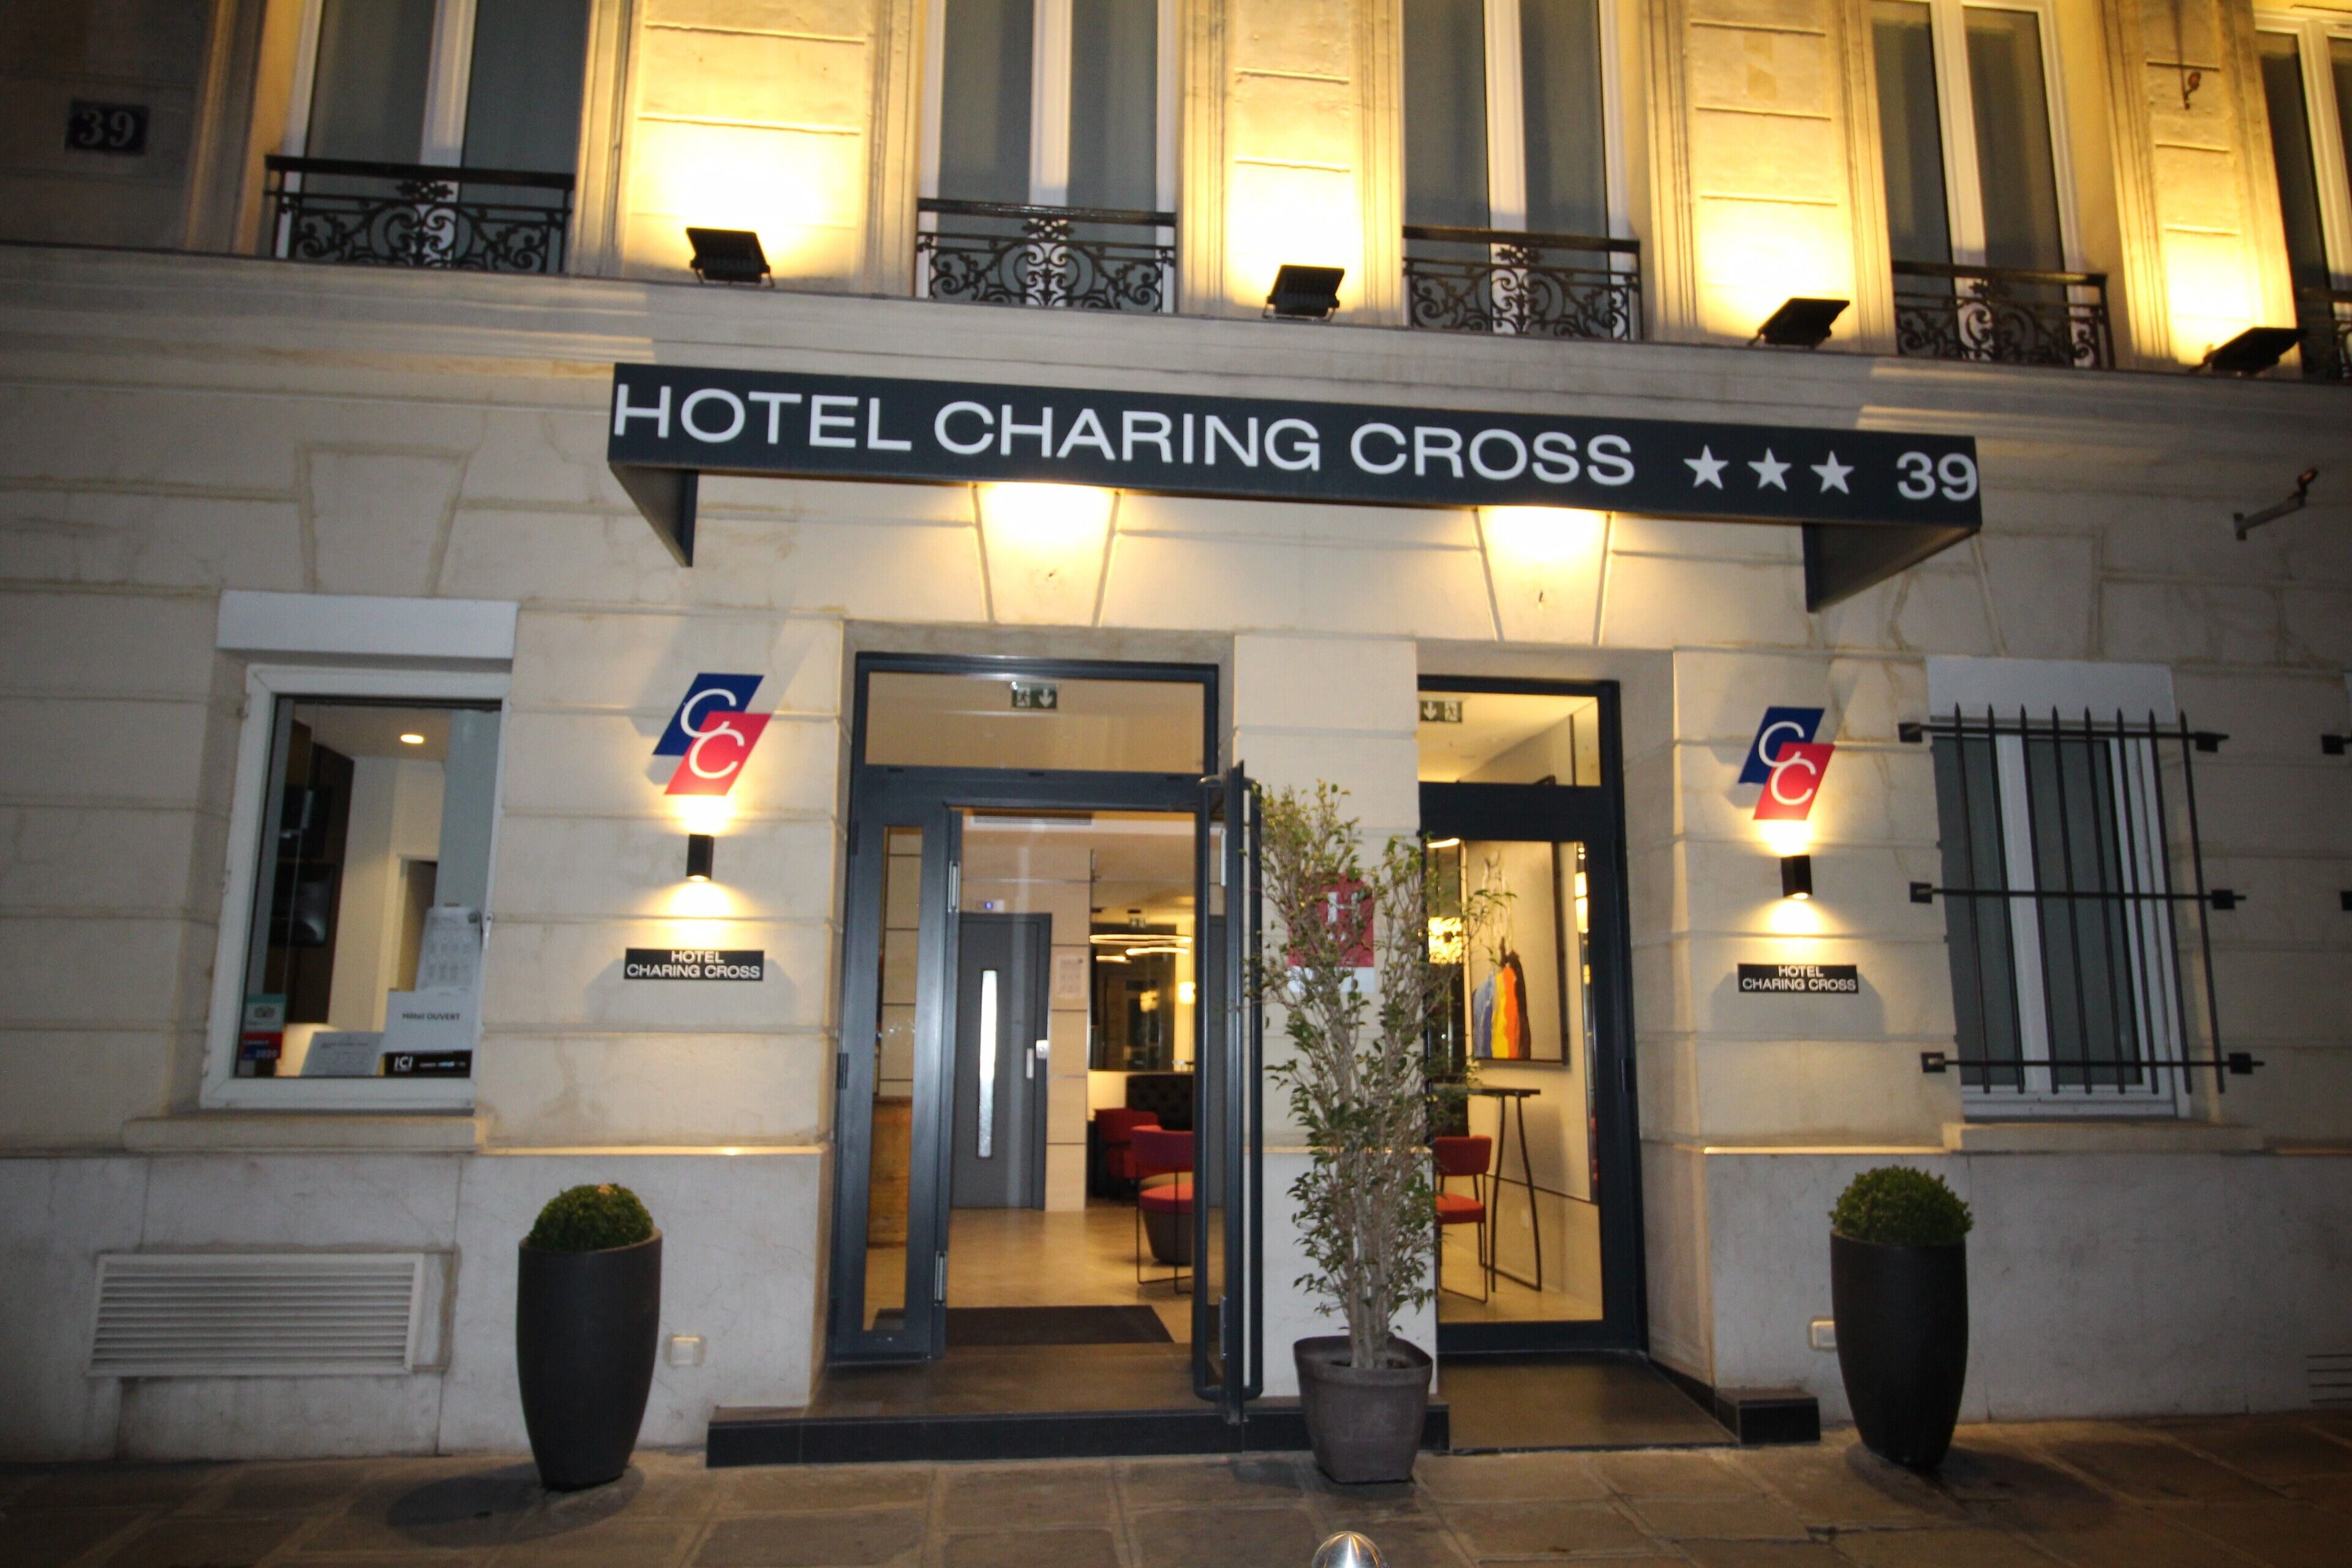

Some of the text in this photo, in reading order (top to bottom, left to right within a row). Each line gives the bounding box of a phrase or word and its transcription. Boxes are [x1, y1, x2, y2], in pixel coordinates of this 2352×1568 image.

[78, 110, 135, 147] 39
[614, 383, 1978, 501] HOTEL CHARING CROSS 39
[671, 950, 725, 963] HOTEL
[626, 963, 761, 979] CHARING CROSS
[1778, 965, 1824, 978] HOTEL
[1742, 978, 1856, 992] CHARING CROSS
